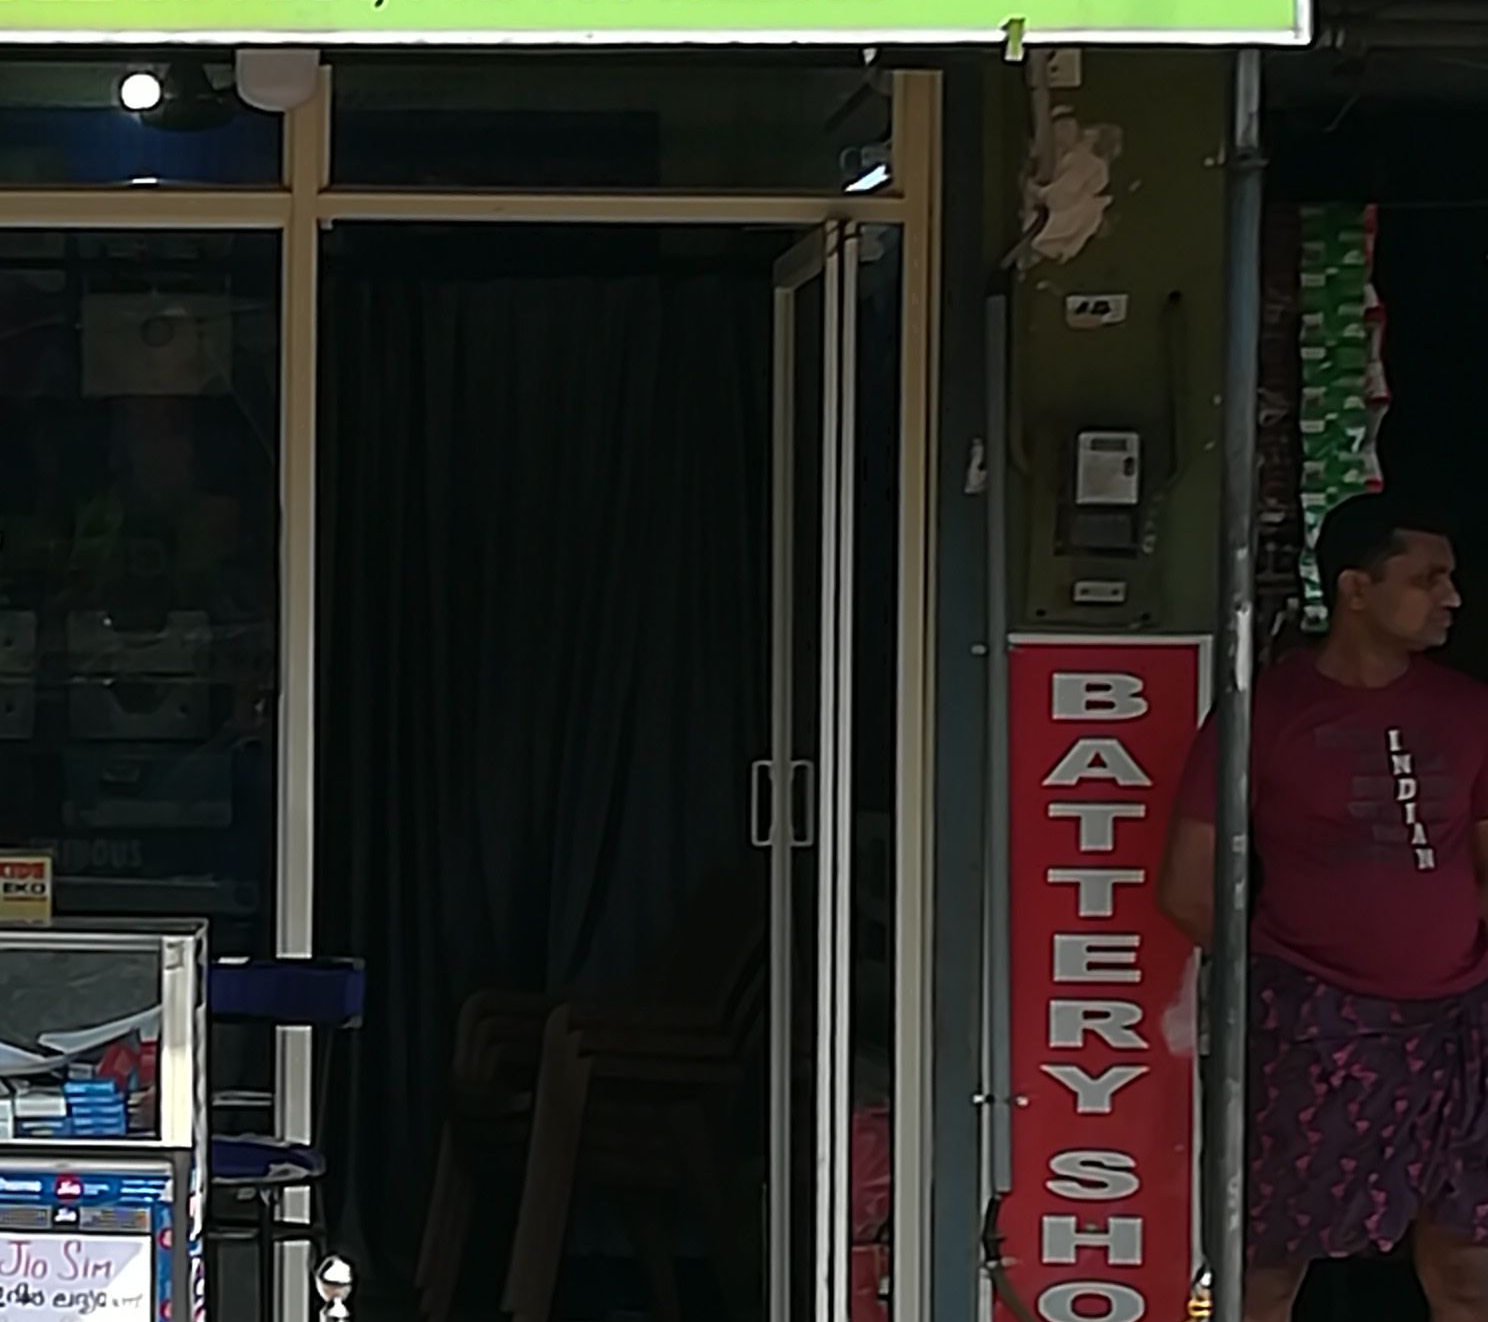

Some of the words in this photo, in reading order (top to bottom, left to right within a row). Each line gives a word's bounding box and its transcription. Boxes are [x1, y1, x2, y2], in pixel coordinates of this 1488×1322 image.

[1386, 728, 1437, 872] INDIAN
[2, 881, 47, 896] EKO
[1039, 671, 1155, 1116] BATTERY
